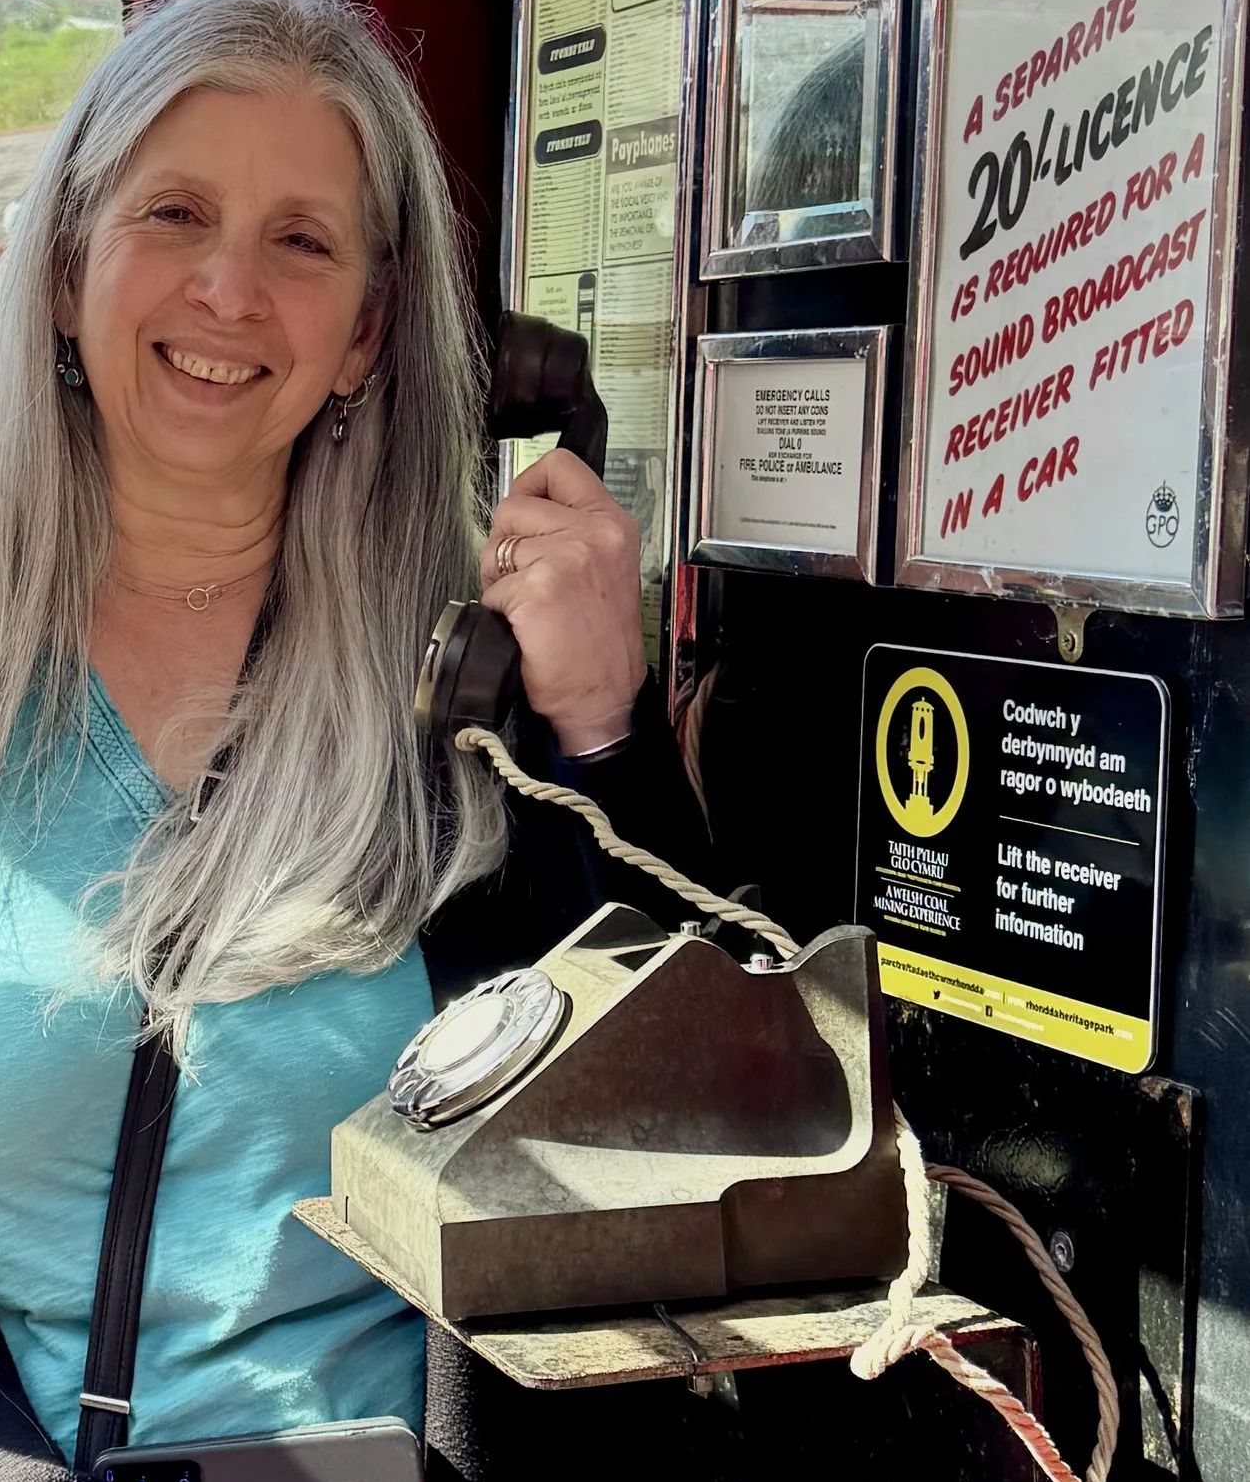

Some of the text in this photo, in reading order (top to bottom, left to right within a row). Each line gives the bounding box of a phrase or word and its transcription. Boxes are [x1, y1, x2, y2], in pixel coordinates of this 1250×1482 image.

[963, 94, 984, 143] A
[1054, 25, 1212, 186] LICENCE
[611, 130, 676, 166] Payphones
[951, 132, 1205, 322] IS REQUIRED FOR A
[950, 209, 1206, 396] SOUND BROADCAST
[755, 389, 830, 402] EMERGENCY CALLS
[945, 298, 1195, 465] RECEIVER FITTED
[755, 405, 828, 416] DO NOT INSERT ANY COINS
[779, 437, 795, 450] DIAL
[739, 458, 842, 475] FIRE, POLICE or AMBULANCE
[940, 435, 1079, 540] IN A CAR
[1146, 513, 1179, 537] GPO
[1002, 699, 1081, 736] Codwch y
[1001, 733, 1126, 774] derbynnydd am
[1000, 768, 1152, 813] ragor o wybodaeth
[888, 840, 949, 867] TAITH PYLLAU
[891, 855, 944, 879] GLO CYMRU
[997, 842, 1121, 892] Lift the receiver
[873, 895, 908, 917] MINING
[909, 905, 961, 931] EXPERIENCE
[885, 885, 949, 913] A WELSH COAL
[996, 877, 1075, 915] for further
[995, 910, 1085, 952] information
[1025, 1000, 1115, 1035] rhonddaheritagepark
